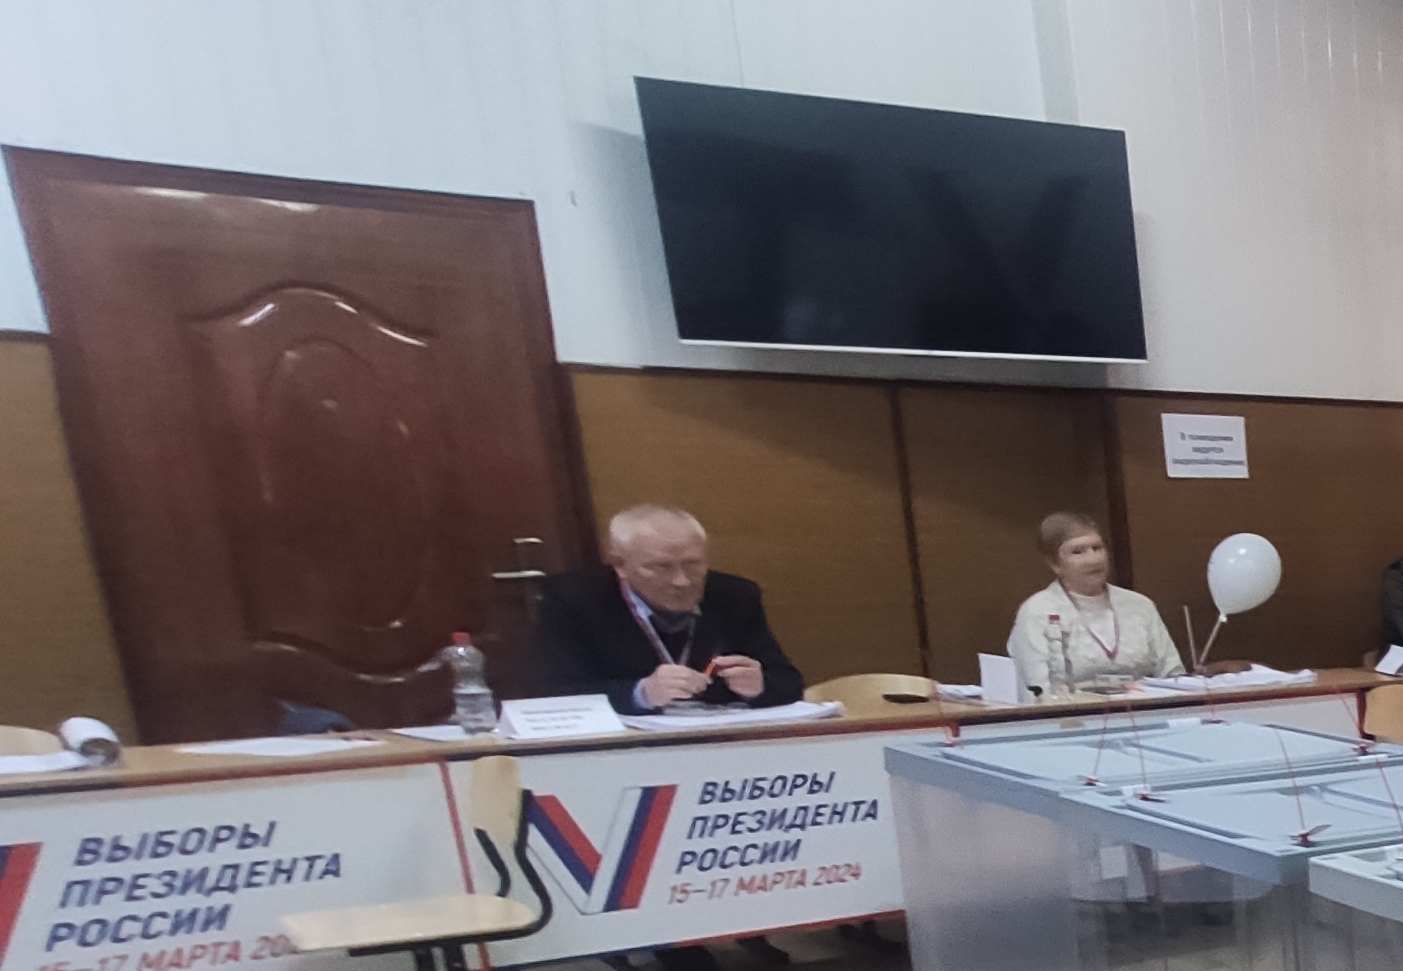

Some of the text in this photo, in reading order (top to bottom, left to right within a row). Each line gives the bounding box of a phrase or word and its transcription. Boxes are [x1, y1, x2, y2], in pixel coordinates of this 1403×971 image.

[698, 771, 835, 805] ВЫБОРЫ
[686, 799, 878, 839] ПРЕЗИДЕНТА
[74, 821, 277, 866] ВЫБОРЫ
[676, 839, 802, 874] РОССИИ
[59, 853, 341, 908] ПРЕЗИДЕНТА
[734, 869, 807, 896] МАРТА
[812, 862, 862, 886] 2024
[45, 903, 233, 952] РОССИИ
